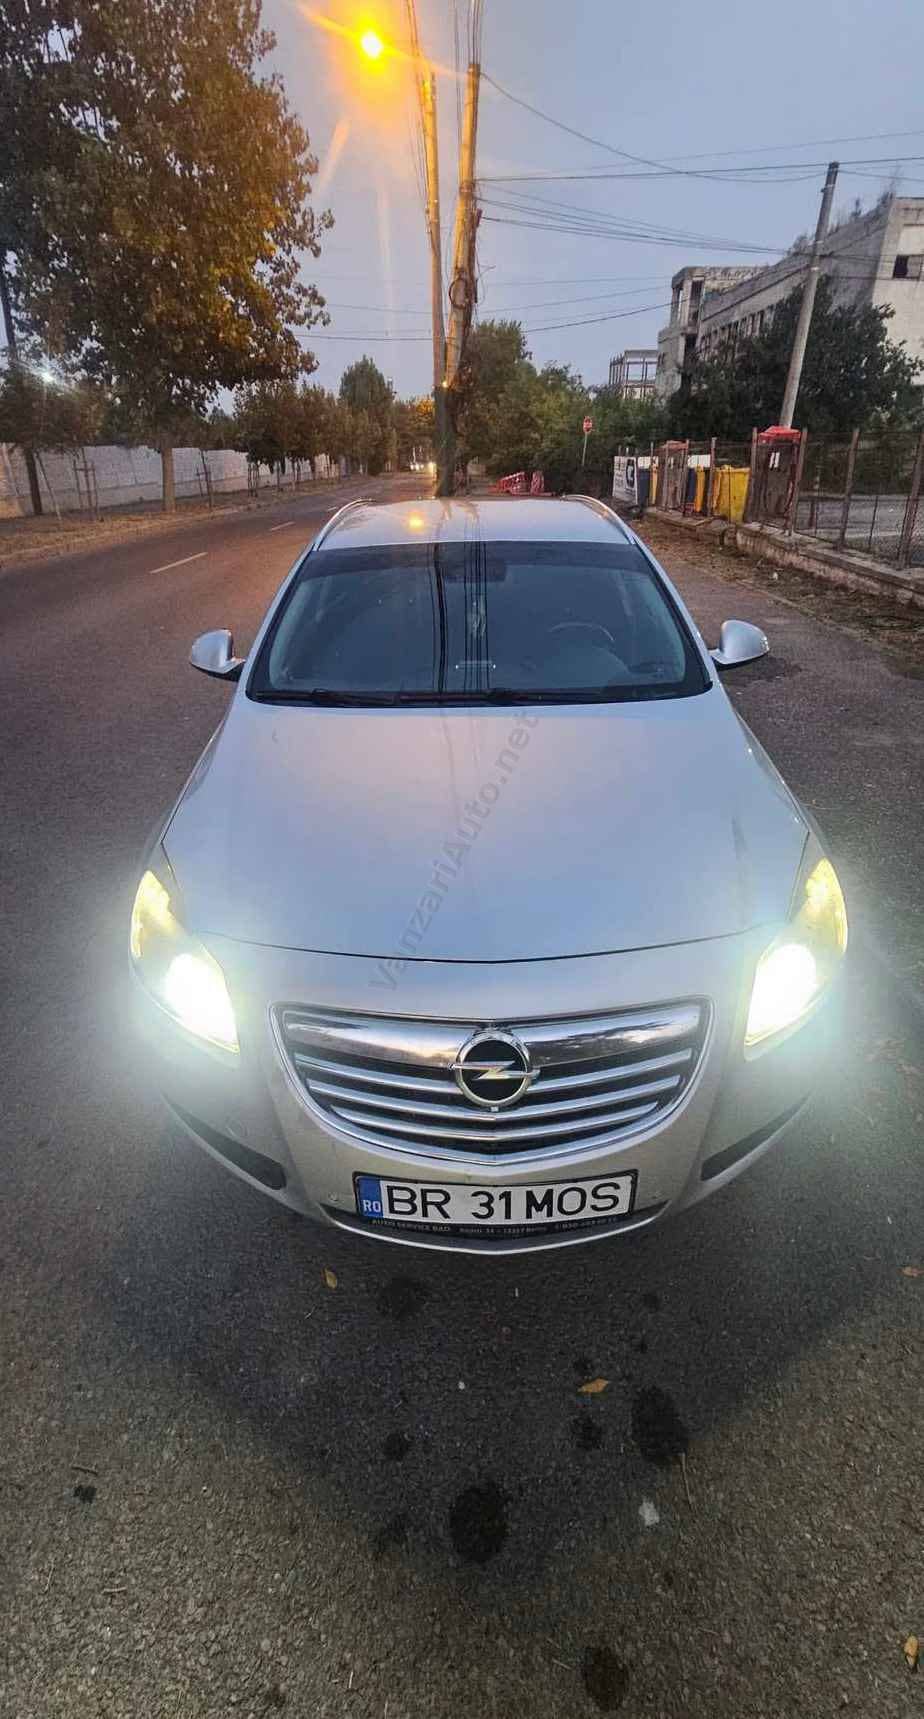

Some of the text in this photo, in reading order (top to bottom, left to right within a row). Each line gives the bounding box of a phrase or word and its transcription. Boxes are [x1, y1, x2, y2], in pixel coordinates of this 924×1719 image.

[362, 1199, 381, 1214] RO
[387, 1182, 621, 1220] BR 31 MOS
